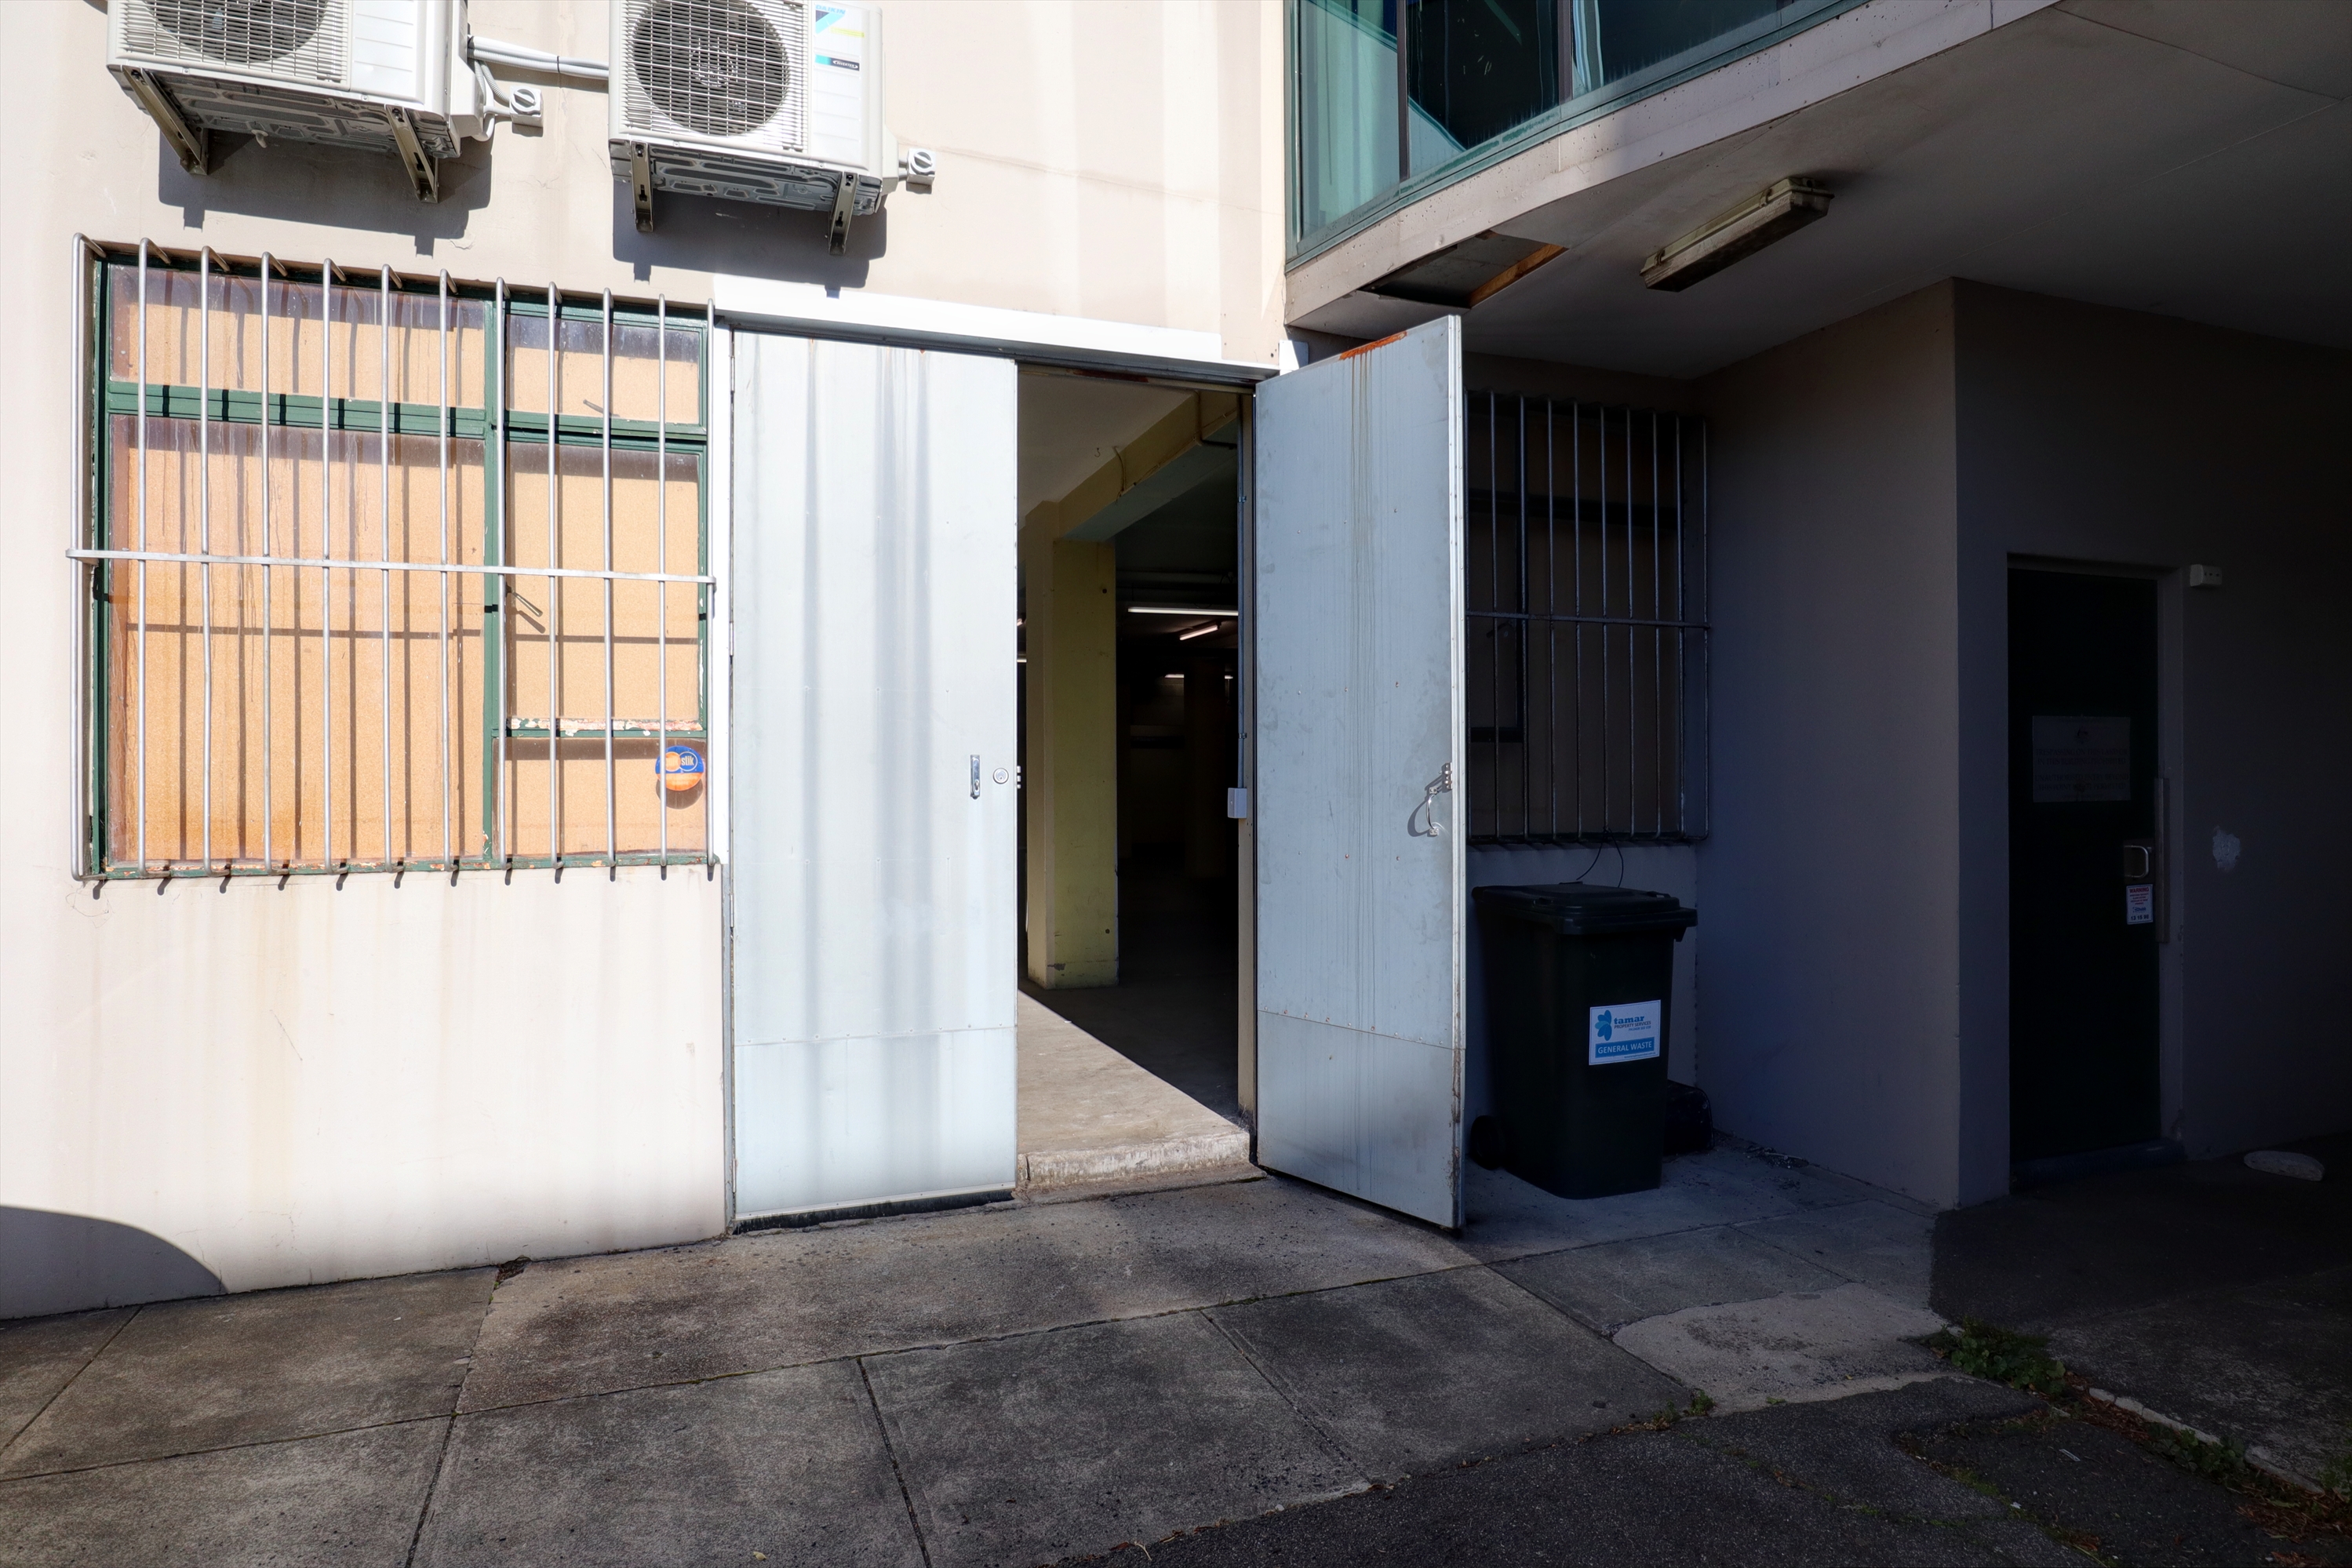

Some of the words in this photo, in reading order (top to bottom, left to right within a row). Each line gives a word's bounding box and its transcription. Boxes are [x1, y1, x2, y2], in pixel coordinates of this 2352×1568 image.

[815, 4, 846, 15] DAIKIN
[1614, 1015, 1644, 1024] tamar
[1597, 1043, 1629, 1054] GENERAL
[1630, 1040, 1652, 1051] WASTE
